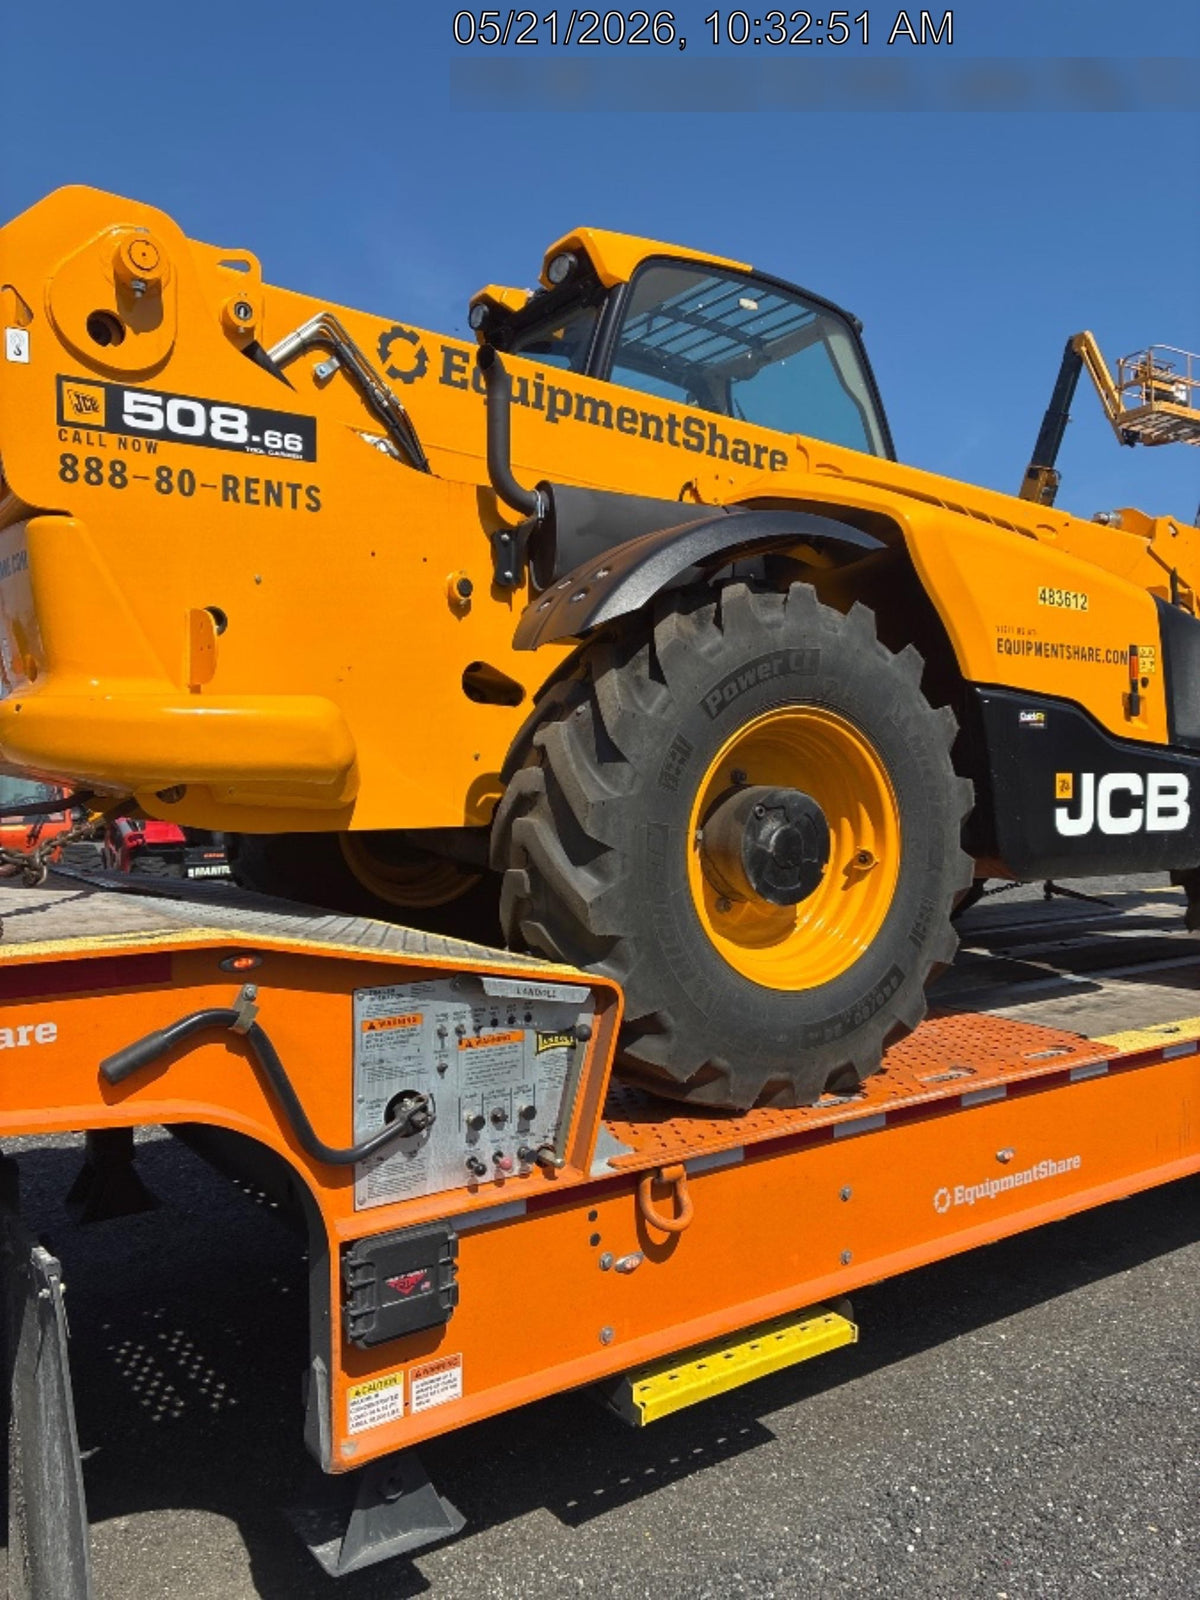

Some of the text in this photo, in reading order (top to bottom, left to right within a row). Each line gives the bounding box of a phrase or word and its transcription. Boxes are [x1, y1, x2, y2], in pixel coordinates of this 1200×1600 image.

[58, 428, 158, 454] CALL NOW
[58, 452, 321, 513] 888-80-RENTS
[1039, 588, 1088, 610] 483612
[704, 657, 783, 718] Power
[1055, 772, 1191, 836] JCB
[954, 1154, 1081, 1205] EquipmentShare
